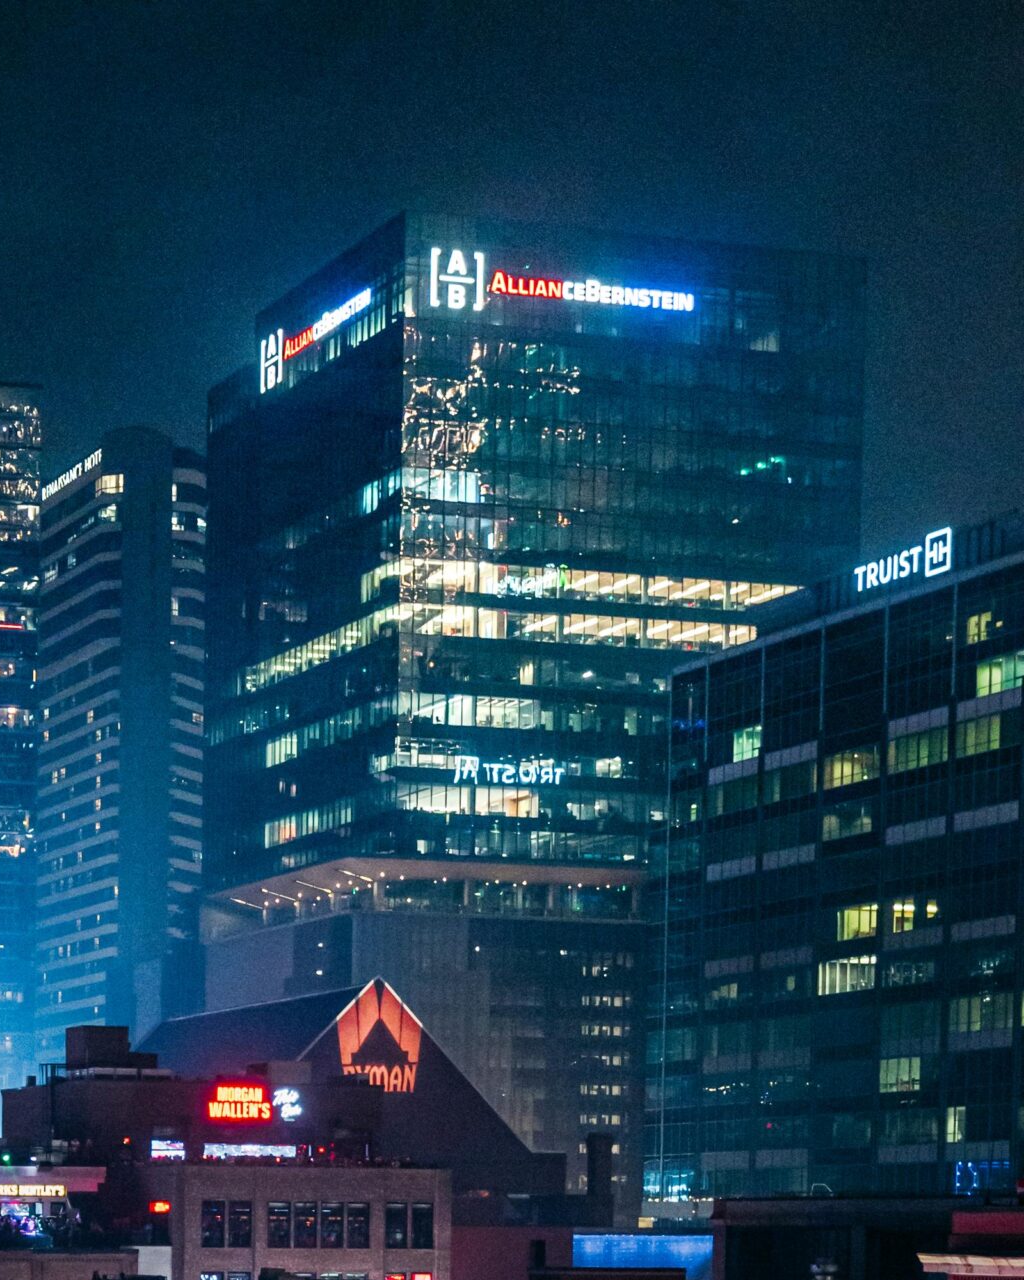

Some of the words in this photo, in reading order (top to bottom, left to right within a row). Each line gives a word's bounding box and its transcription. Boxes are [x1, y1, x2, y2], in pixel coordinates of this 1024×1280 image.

[854, 545, 923, 592] TRUIST
[217, 1086, 263, 1102] MORGAN
[208, 1102, 271, 1119] WALLEN'S
